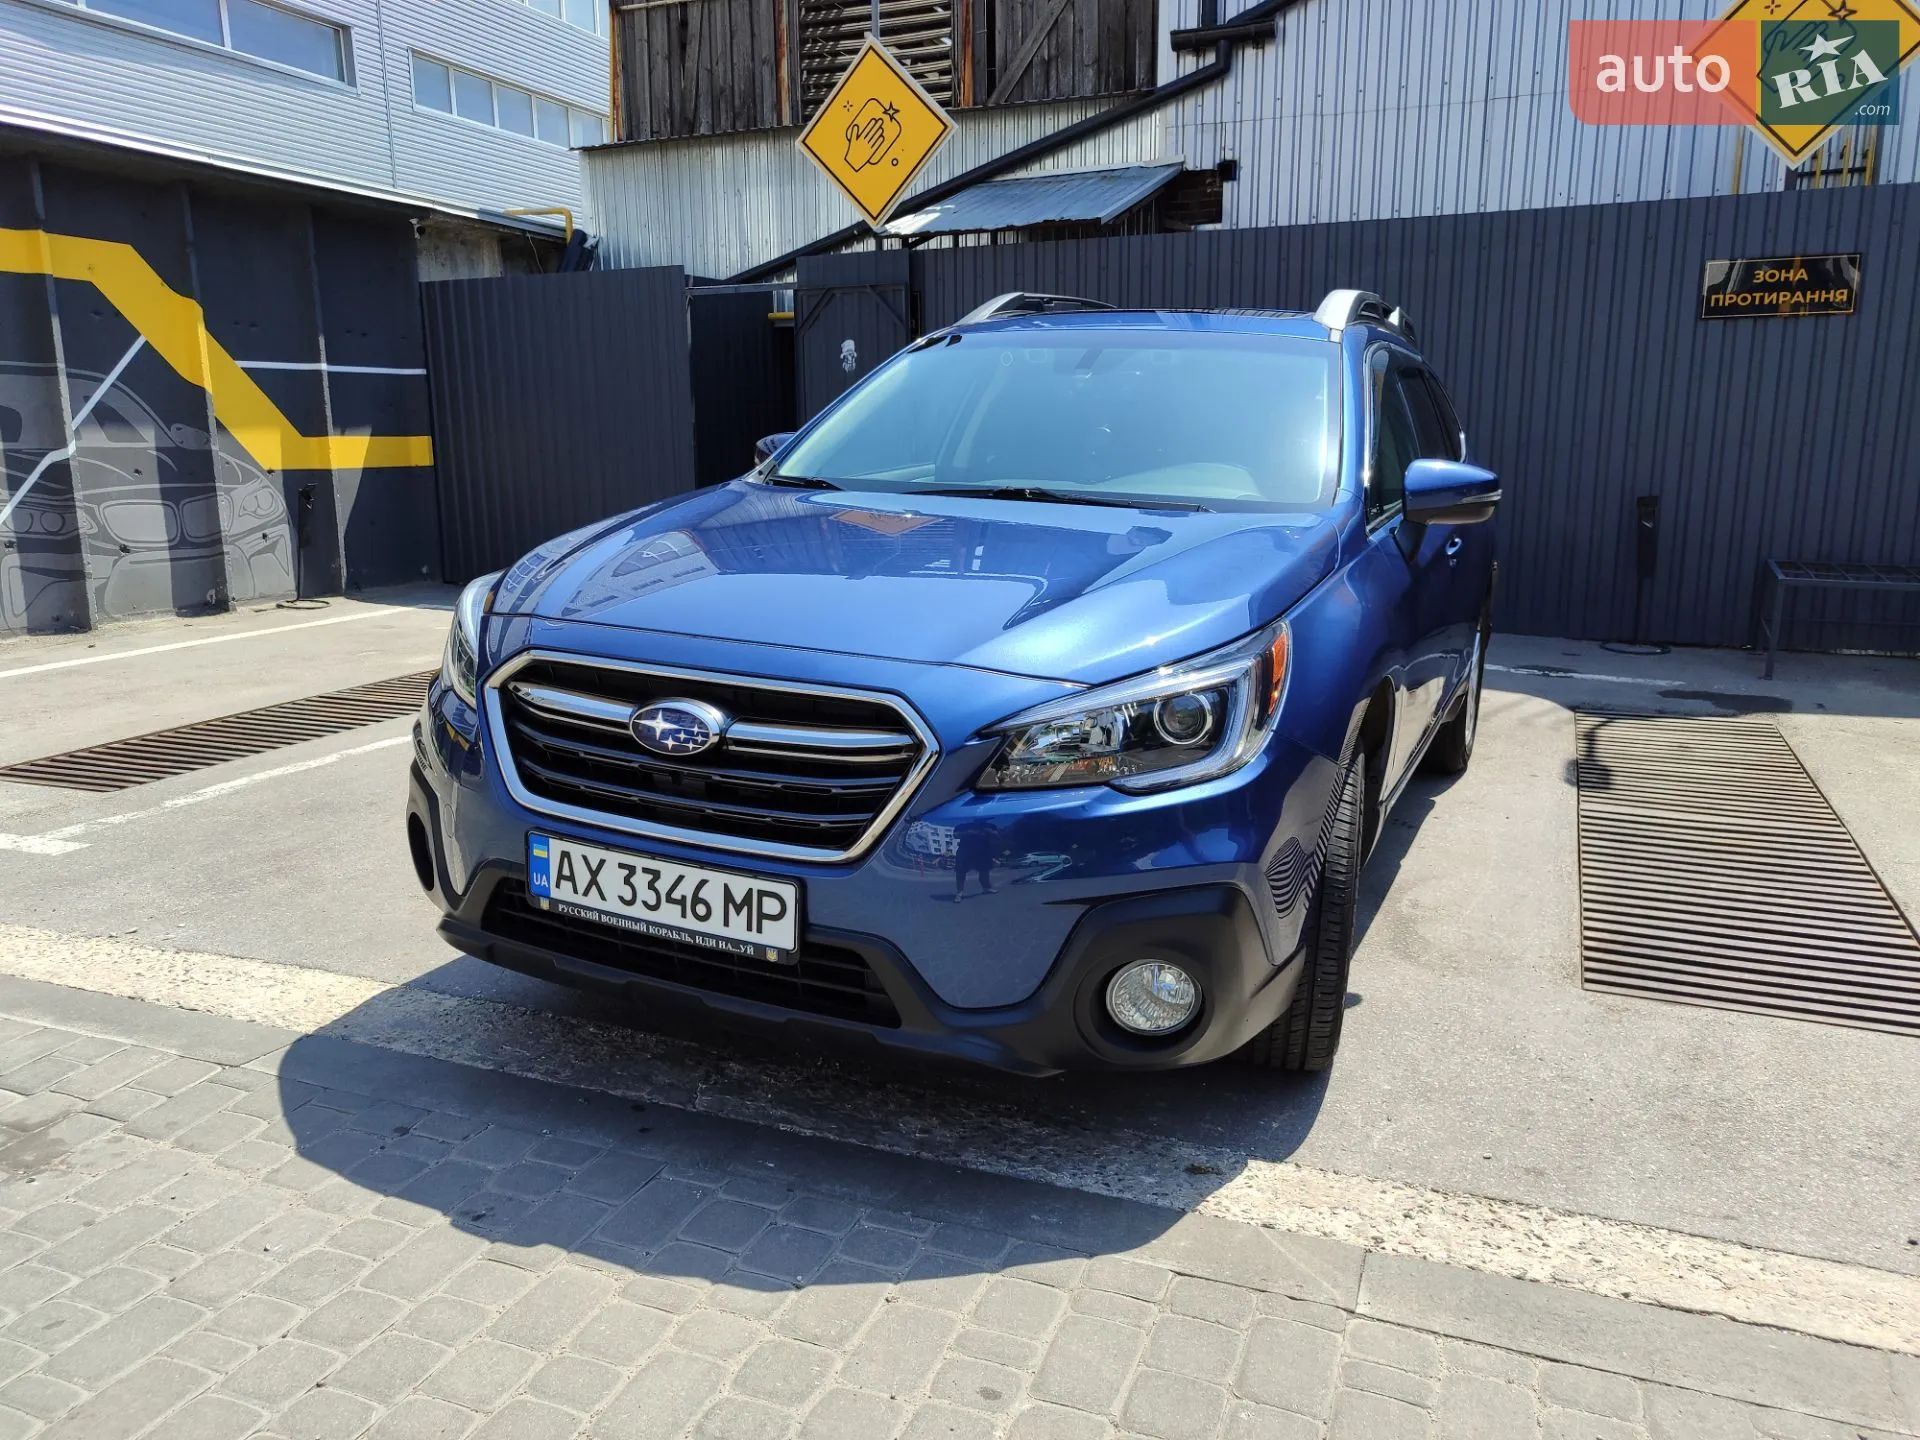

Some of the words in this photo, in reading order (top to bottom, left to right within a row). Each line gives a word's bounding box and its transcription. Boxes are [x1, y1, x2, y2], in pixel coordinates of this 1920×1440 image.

[1753, 269, 1808, 283] ЗОНА
[1710, 289, 1848, 307] ПРОТИРАННЯ
[533, 872, 548, 888] UA
[555, 850, 607, 902] AX
[617, 862, 712, 923] 3346
[723, 882, 787, 934] MP
[558, 903, 599, 921] РУССКИЙ
[601, 914, 647, 932] ВОЕННЫЙ
[649, 925, 694, 944] КОРАБЛЬ,
[695, 935, 716, 948] ИДИ
